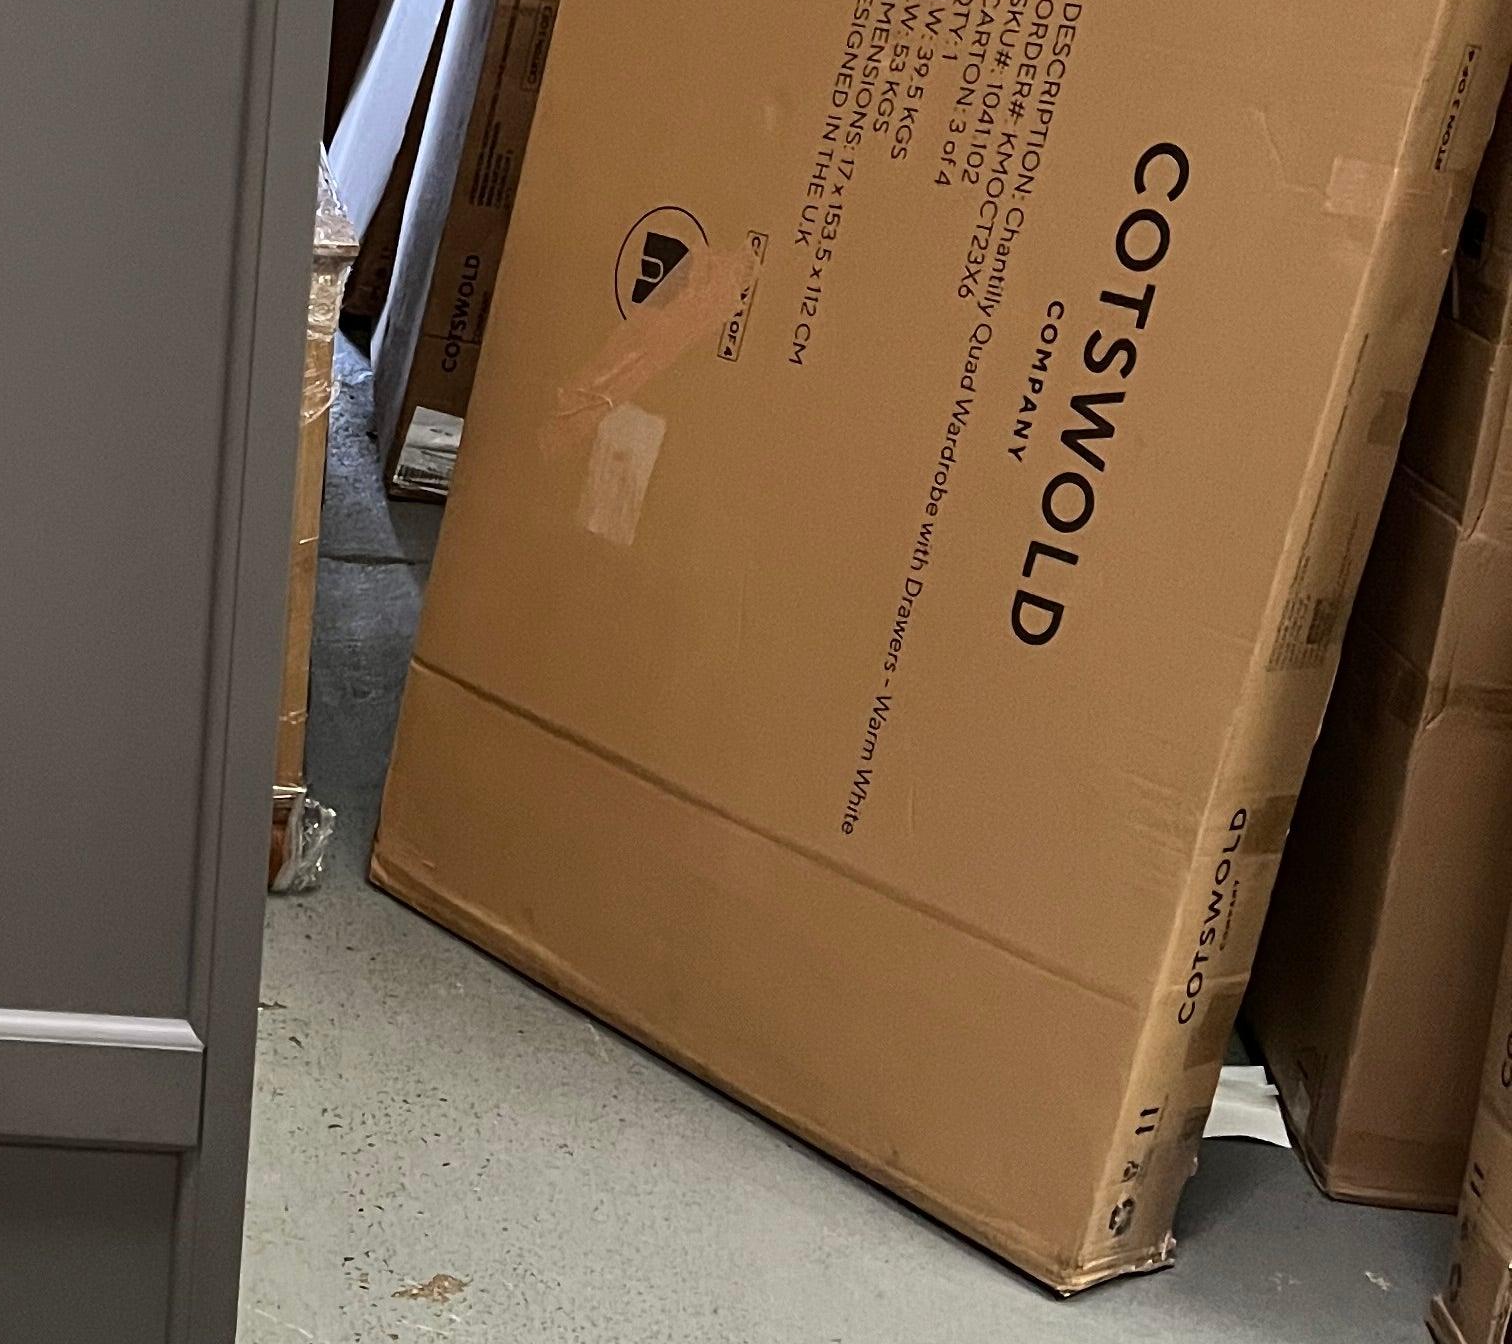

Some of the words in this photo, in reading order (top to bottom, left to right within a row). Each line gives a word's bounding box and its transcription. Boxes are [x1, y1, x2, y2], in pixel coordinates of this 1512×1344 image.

[889, 44, 909, 74] 53
[905, 46, 934, 100] 39.5
[941, 53, 958, 62] 1
[873, 81, 900, 134] KGS
[949, 119, 966, 133] 3
[1010, 2, 1083, 201] DESCRIPTION:
[821, 116, 843, 143] IN
[890, 106, 916, 161] KGS
[940, 140, 957, 166] of
[806, 150, 834, 198] THE
[831, 185, 843, 197] x
[837, 157, 855, 181] 17
[934, 169, 952, 187] 4
[794, 204, 819, 245] U.K
[815, 203, 842, 263] 153.5
[957, 131, 1019, 299] KMOCT23X6
[809, 268, 822, 280] x
[976, 206, 1025, 318] Chantilly
[441, 254, 481, 374] COTSWOLD
[801, 285, 823, 320] 112
[788, 323, 811, 366] CM
[960, 323, 993, 393] Quad
[1008, 300, 1065, 463] COMPANY
[1010, 142, 1190, 646] COTSWOLD
[926, 398, 974, 517] Wardrobe
[909, 522, 934, 572] with
[883, 577, 923, 673] Drawers
[857, 696, 893, 761] Warm
[840, 768, 874, 835] White
[1178, 808, 1247, 1025] COTSWOLD
